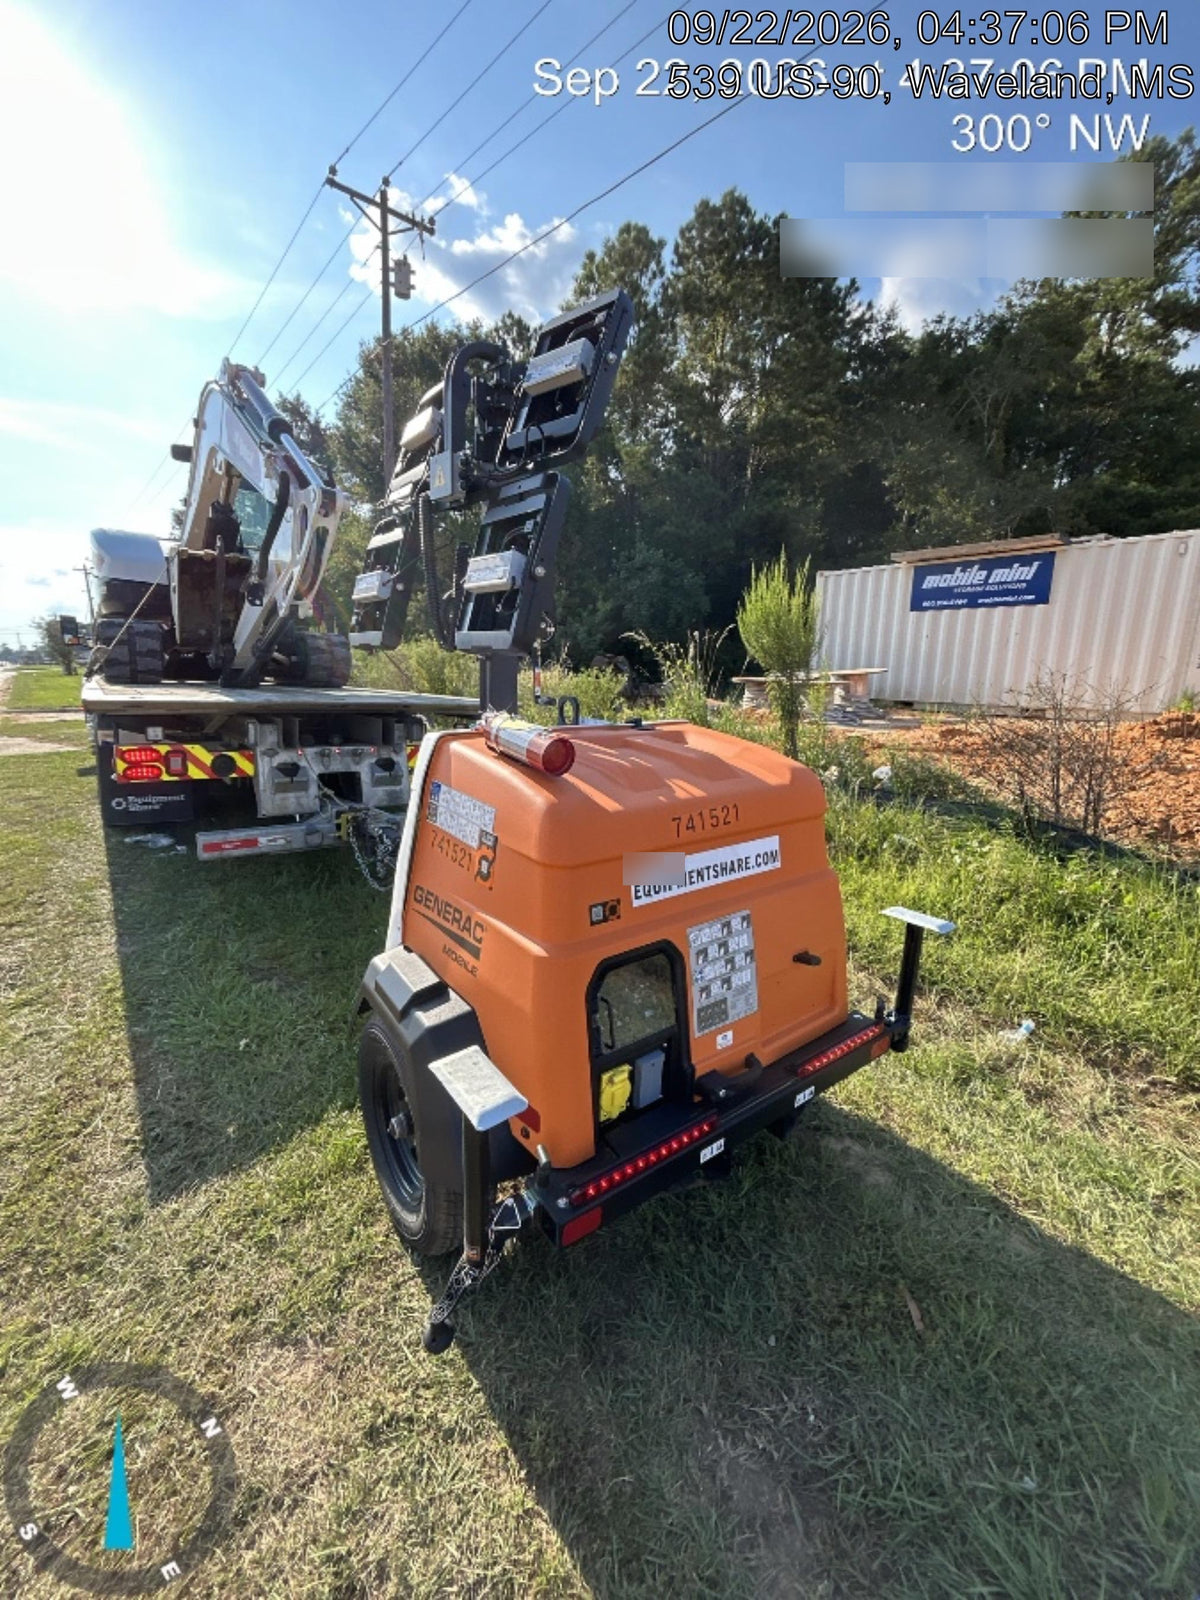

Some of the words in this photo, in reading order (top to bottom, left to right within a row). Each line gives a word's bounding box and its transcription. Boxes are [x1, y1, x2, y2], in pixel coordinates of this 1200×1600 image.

[922, 565, 987, 589] mobile
[672, 803, 740, 838] 741521
[431, 829, 473, 872] 741521
[413, 884, 485, 945] GENERAC
